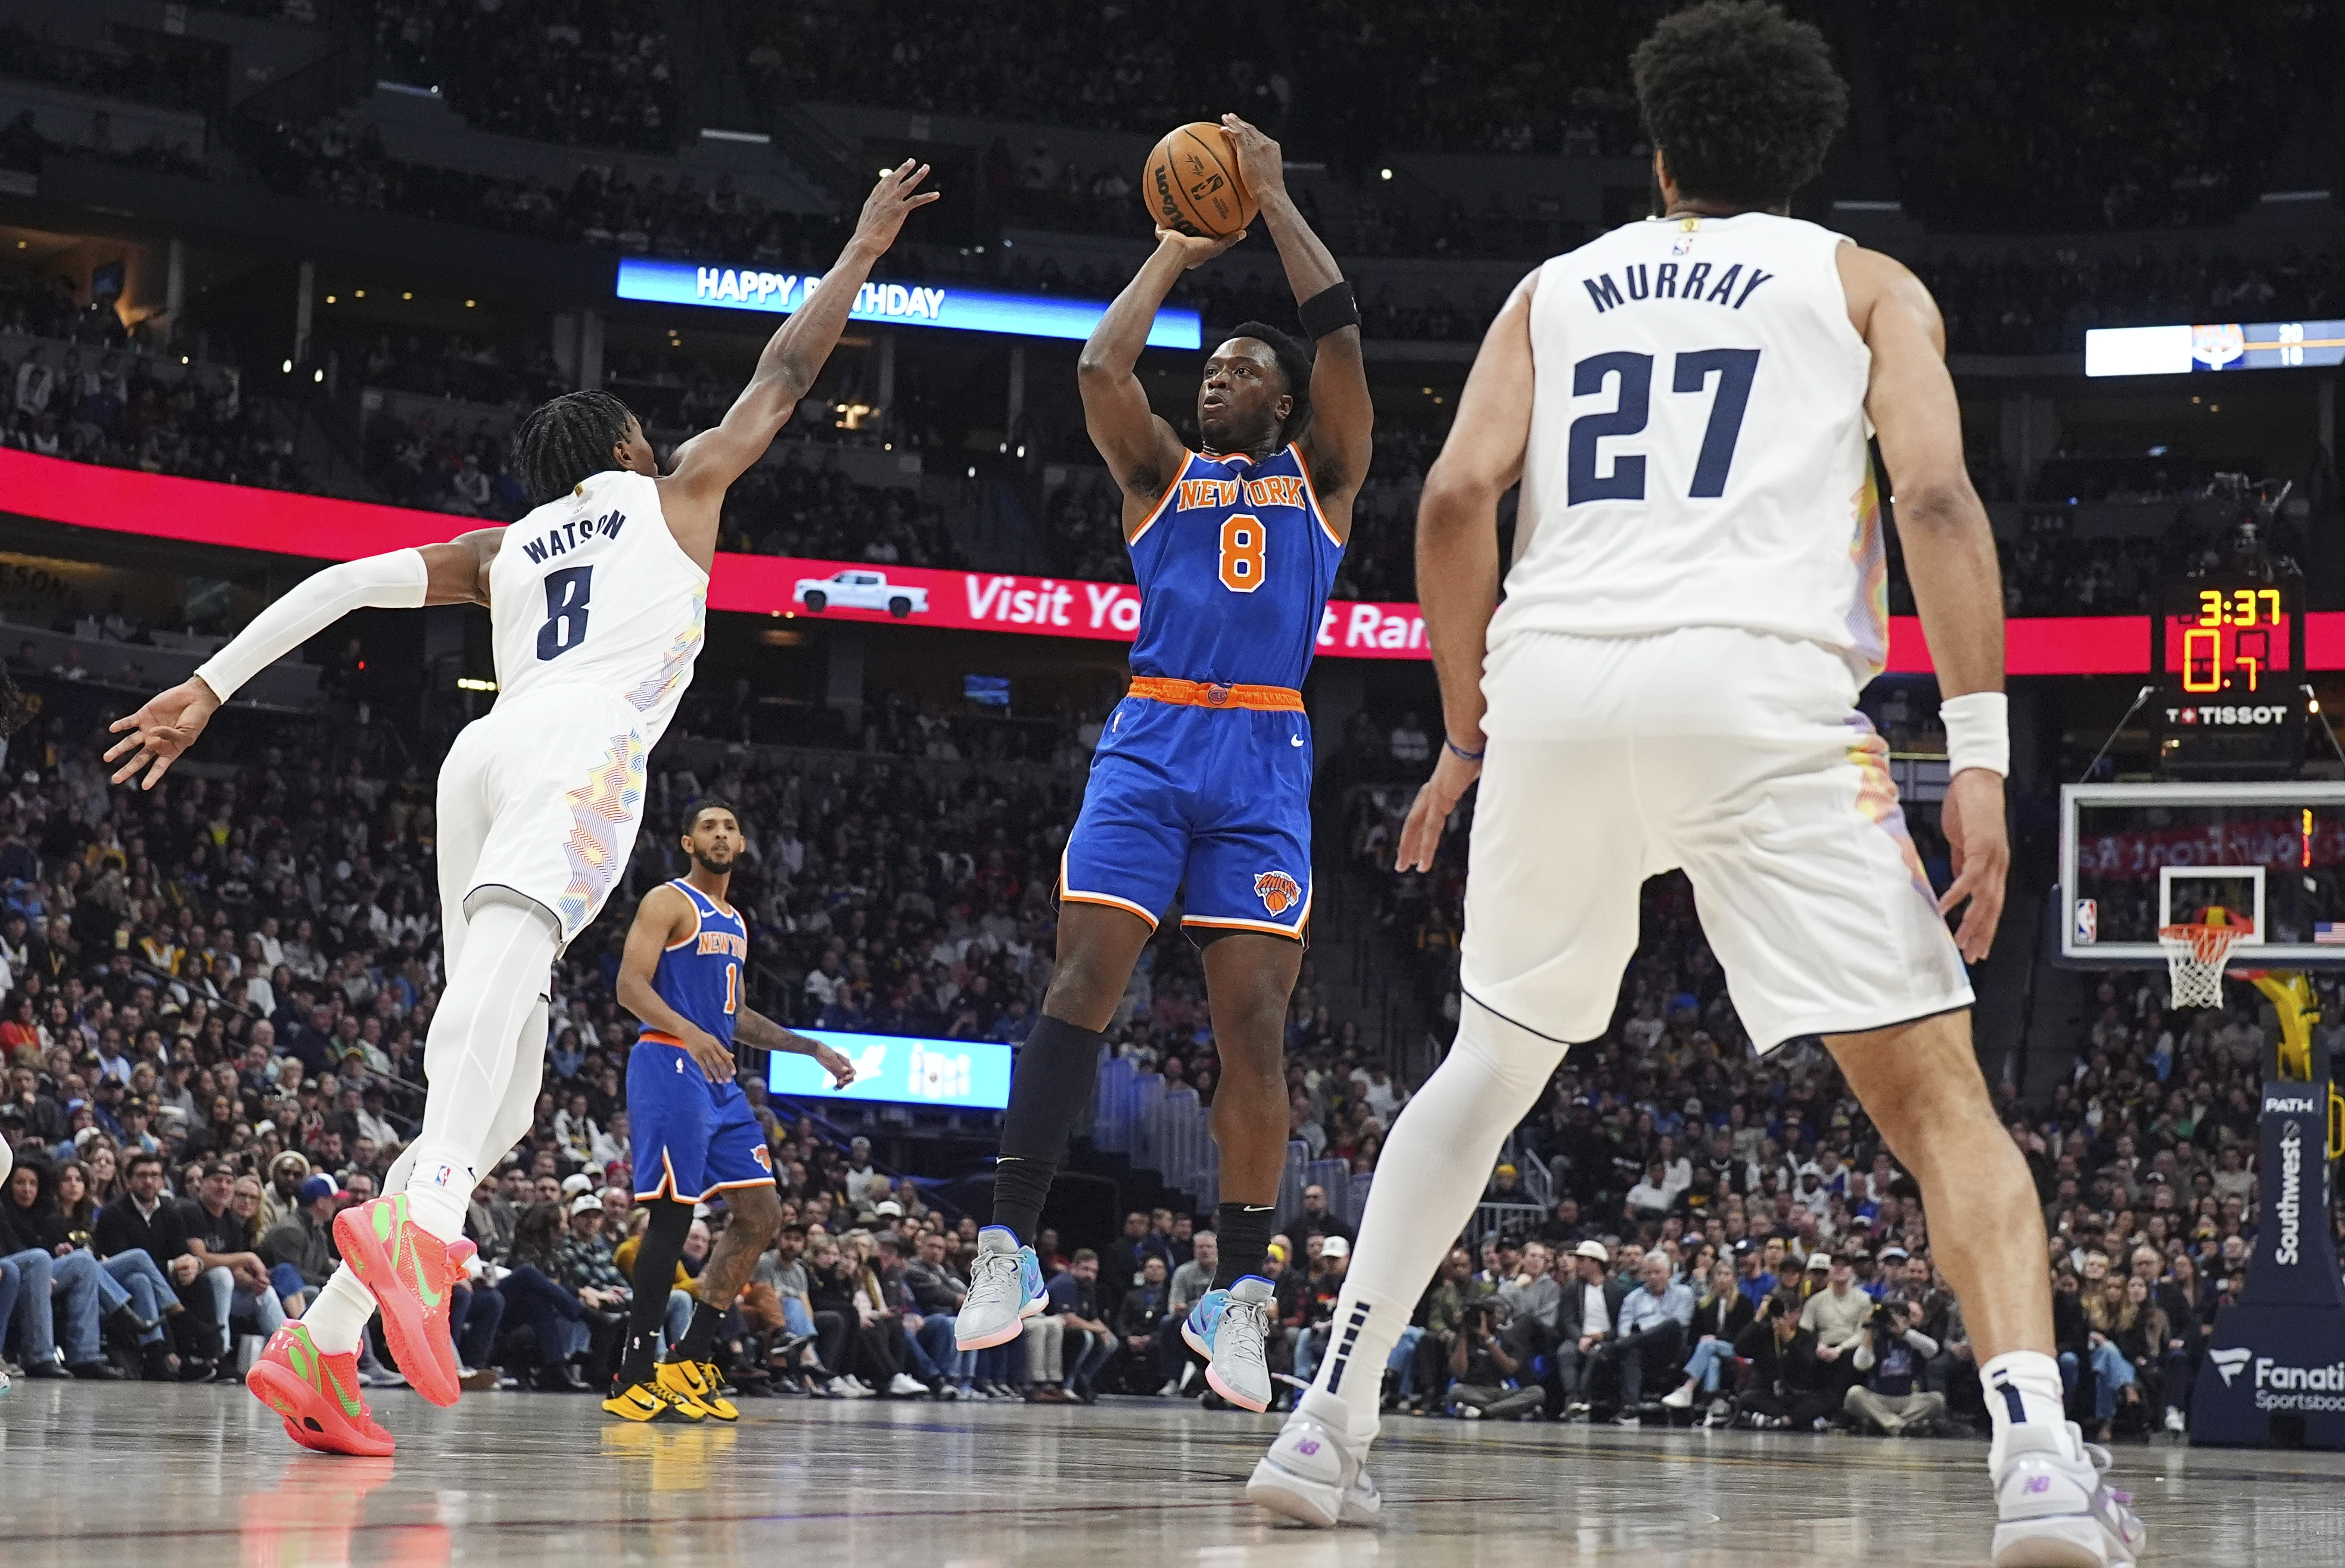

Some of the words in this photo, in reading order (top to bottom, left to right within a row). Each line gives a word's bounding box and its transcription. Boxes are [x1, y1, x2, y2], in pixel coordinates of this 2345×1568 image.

[1155, 165, 1202, 234] Wilson
[696, 266, 797, 306] HAPPY
[803, 276, 945, 319] BTHDAY
[1582, 263, 1775, 313] MURRAY
[1568, 348, 1761, 508] 27
[1176, 473, 1241, 513] NEW
[523, 509, 626, 564] WATSON
[1218, 514, 1267, 593] 8
[537, 564, 595, 661] 8
[966, 574, 1072, 626] Visit
[1086, 584, 1141, 631] Yo
[1346, 603, 1430, 649] Ran
[2200, 590, 2279, 626] 3:37
[2184, 629, 2257, 692] 0.7
[2198, 705, 2288, 724] TISSOT
[1256, 874, 1297, 901] KNICKS
[697, 931, 729, 956] NEW
[727, 934, 747, 964] YO
[723, 962, 737, 1015] 1
[2265, 1097, 2313, 1113] PATH
[2275, 1137, 2302, 1265] Southwest
[2255, 1357, 2345, 1391] Fanati
[2255, 1389, 2345, 1412] Sportsboo
